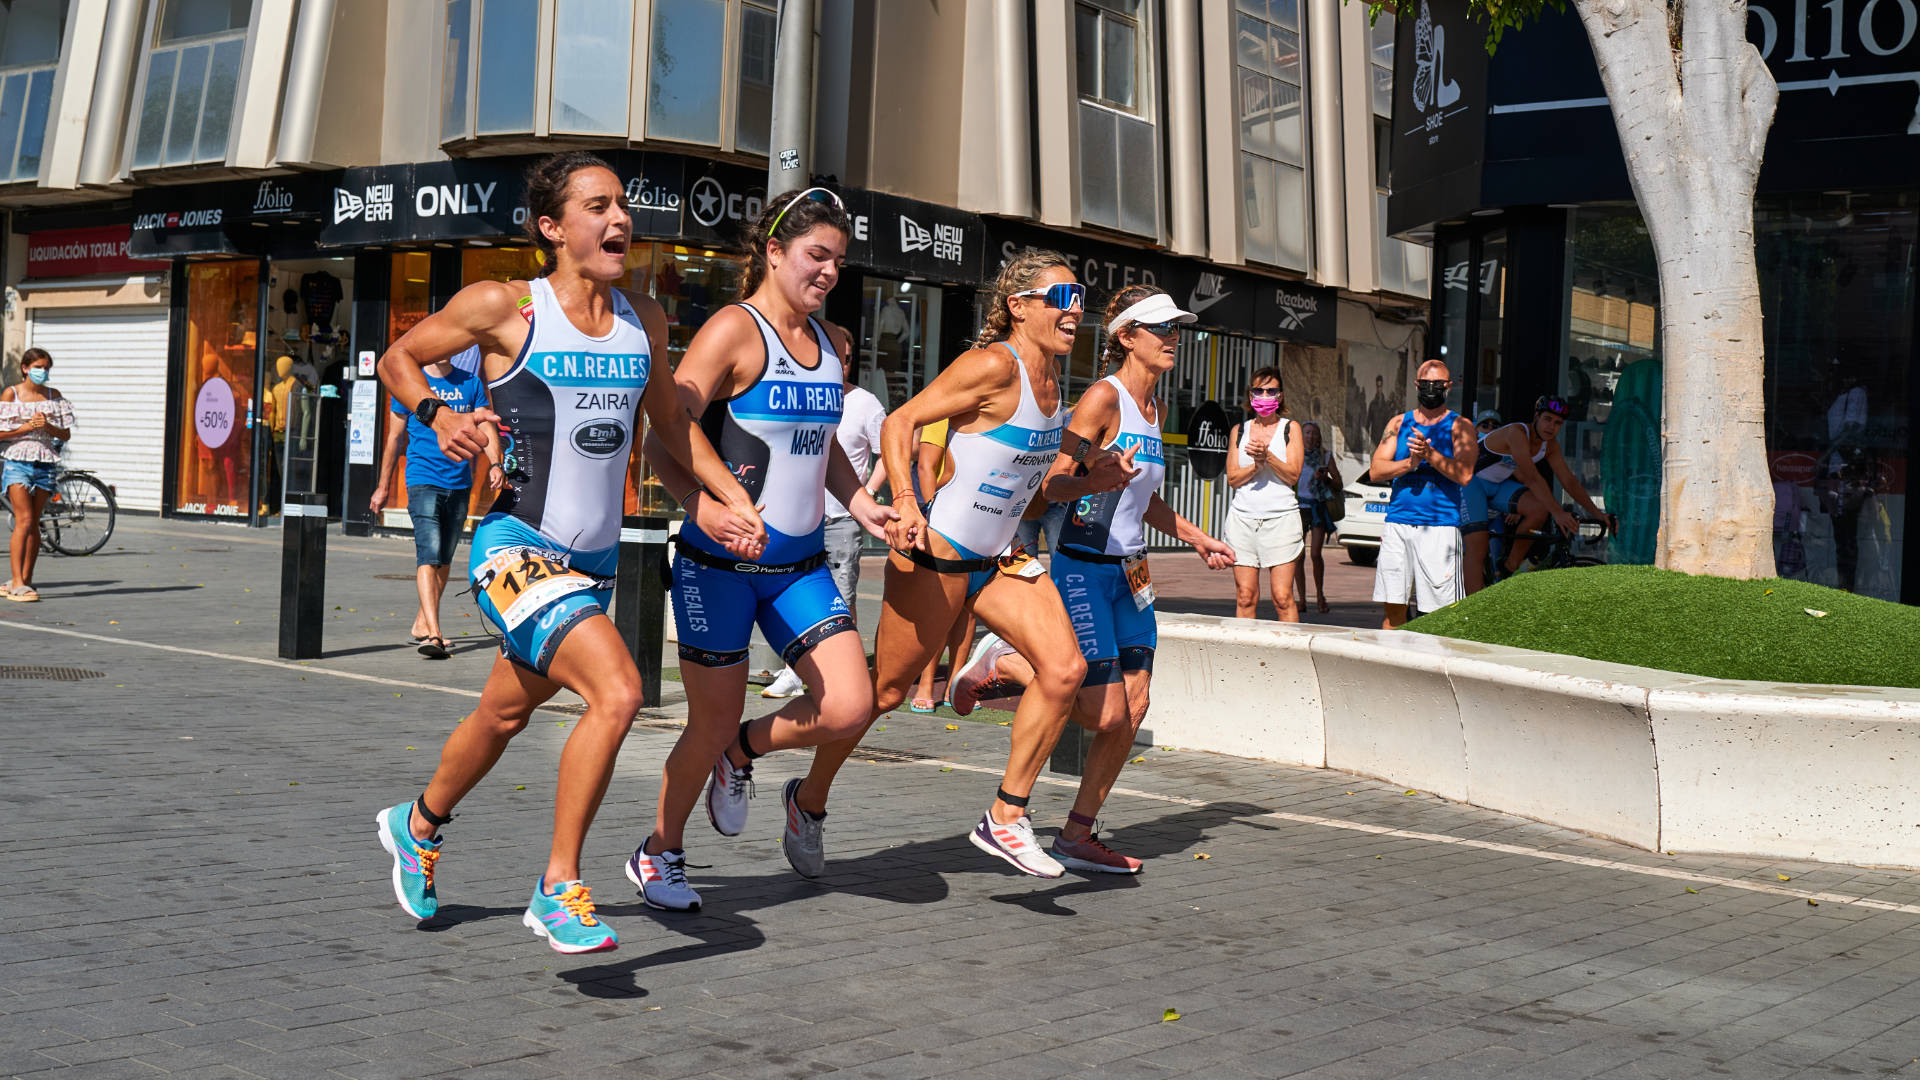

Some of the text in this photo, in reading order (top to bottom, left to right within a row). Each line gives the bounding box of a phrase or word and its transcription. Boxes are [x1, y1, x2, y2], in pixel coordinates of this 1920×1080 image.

[253, 181, 293, 208] ffolio
[365, 184, 393, 203] NEW
[415, 182, 497, 217] ONLY
[133, 209, 223, 230] JACK JONES
[364, 203, 393, 222] ERA
[934, 223, 964, 245] NEW
[29, 241, 88, 262] LIQUIDACIÓN
[89, 242, 117, 257] TOTAL
[933, 243, 963, 262] ERA
[1198, 272, 1226, 296] NIKE
[1276, 289, 1319, 312] Reebok
[575, 392, 630, 410] ZAIRA
[805, 387, 844, 412] REALE
[200, 411, 229, 429] -50%
[790, 425, 826, 455] MARÍA
[1195, 420, 1228, 448] ffolio
[184, 503, 206, 514] JACK
[973, 502, 1003, 515] kenia
[683, 585, 709, 633] REALES
